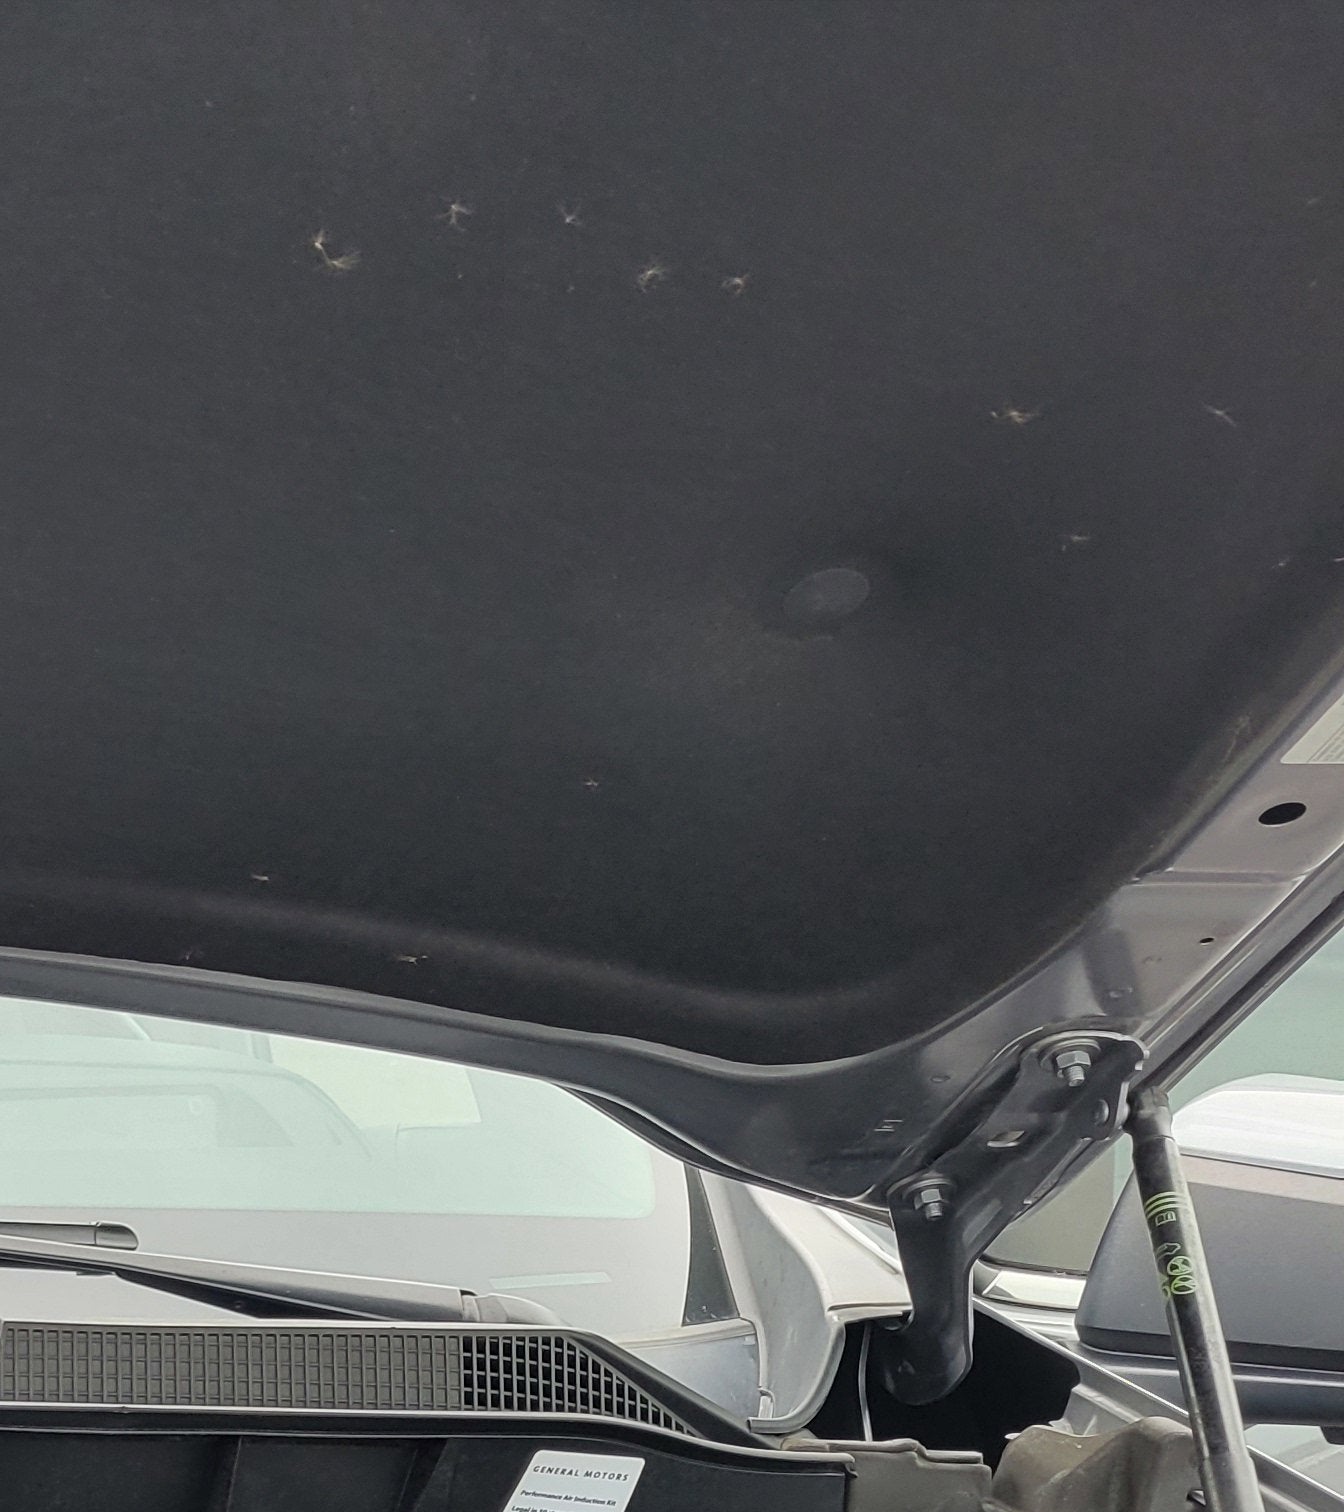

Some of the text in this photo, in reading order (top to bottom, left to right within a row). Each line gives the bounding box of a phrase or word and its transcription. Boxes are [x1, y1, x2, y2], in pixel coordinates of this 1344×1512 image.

[533, 1465, 629, 1482] GENERAL MOTORS
[520, 1490, 562, 1500] Performance
[574, 1496, 606, 1505] Induction
